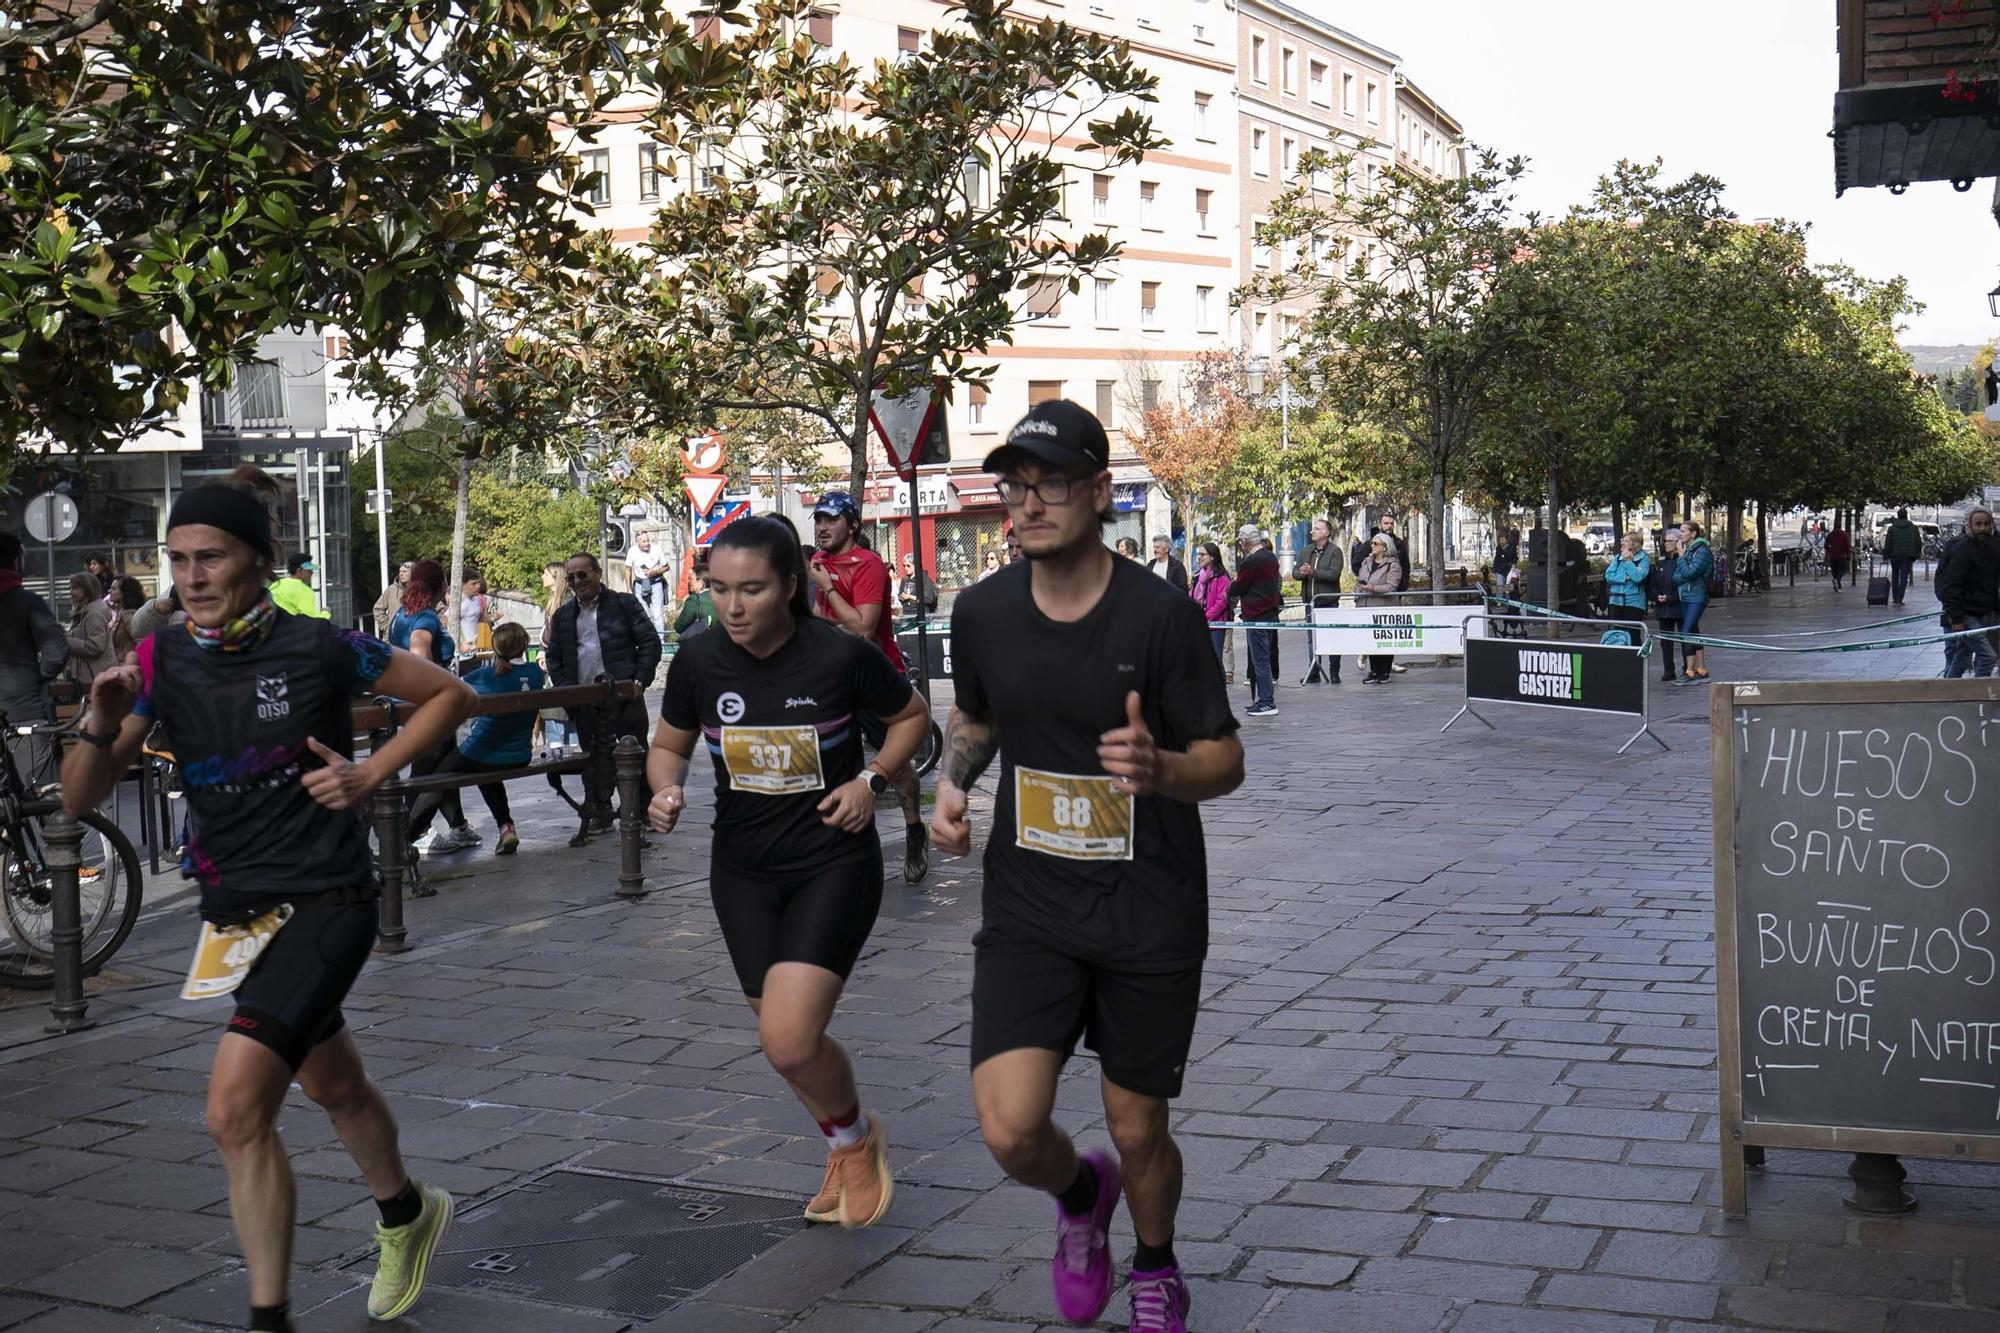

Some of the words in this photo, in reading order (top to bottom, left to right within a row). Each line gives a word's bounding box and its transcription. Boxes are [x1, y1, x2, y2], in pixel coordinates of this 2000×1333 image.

[899, 489, 946, 505] CRTA
[1372, 614, 1412, 626] VITORIA
[1373, 628, 1413, 640] GASTEIZ
[1518, 650, 1572, 676] VITORIA
[1518, 673, 1572, 699] GASTEIZ
[257, 700, 290, 719] OTSO
[748, 744, 791, 770] 337
[1760, 715, 1976, 807] HUESOS
[1052, 795, 1092, 829] 88
[1836, 806, 1875, 832] DE
[1761, 820, 1950, 889] SANTO
[1757, 907, 1995, 986] BUÑUELOS
[1836, 974, 1876, 1007] DE
[1758, 1004, 1871, 1051] CREMA
